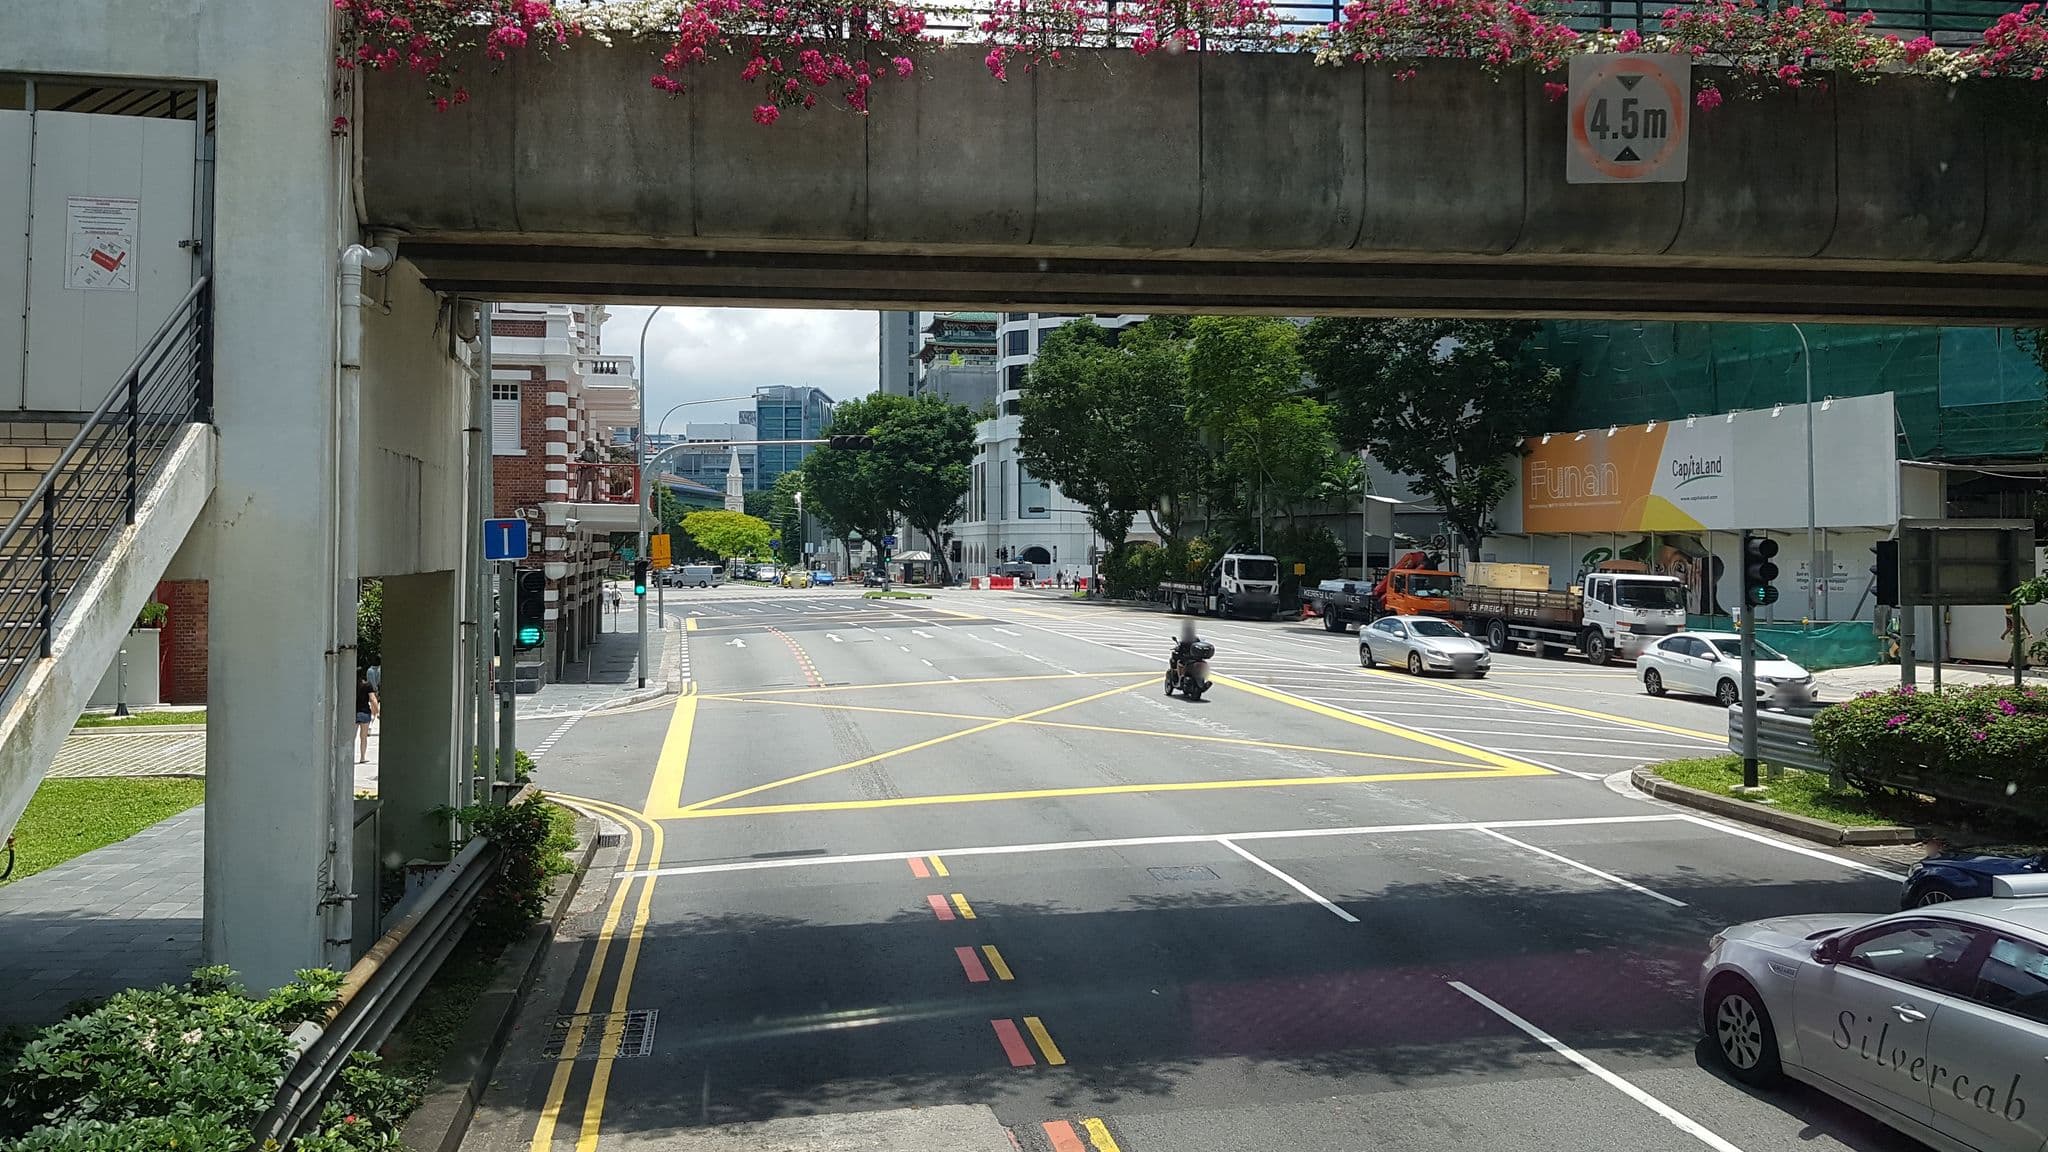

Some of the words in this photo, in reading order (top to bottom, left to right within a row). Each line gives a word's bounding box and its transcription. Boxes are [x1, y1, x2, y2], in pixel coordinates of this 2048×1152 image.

[1590, 98, 1667, 139] 4.5m
[1531, 460, 1619, 500] Funan
[1672, 454, 1722, 480] CapitaLand
[1832, 1010, 2026, 1122] Silvercab
